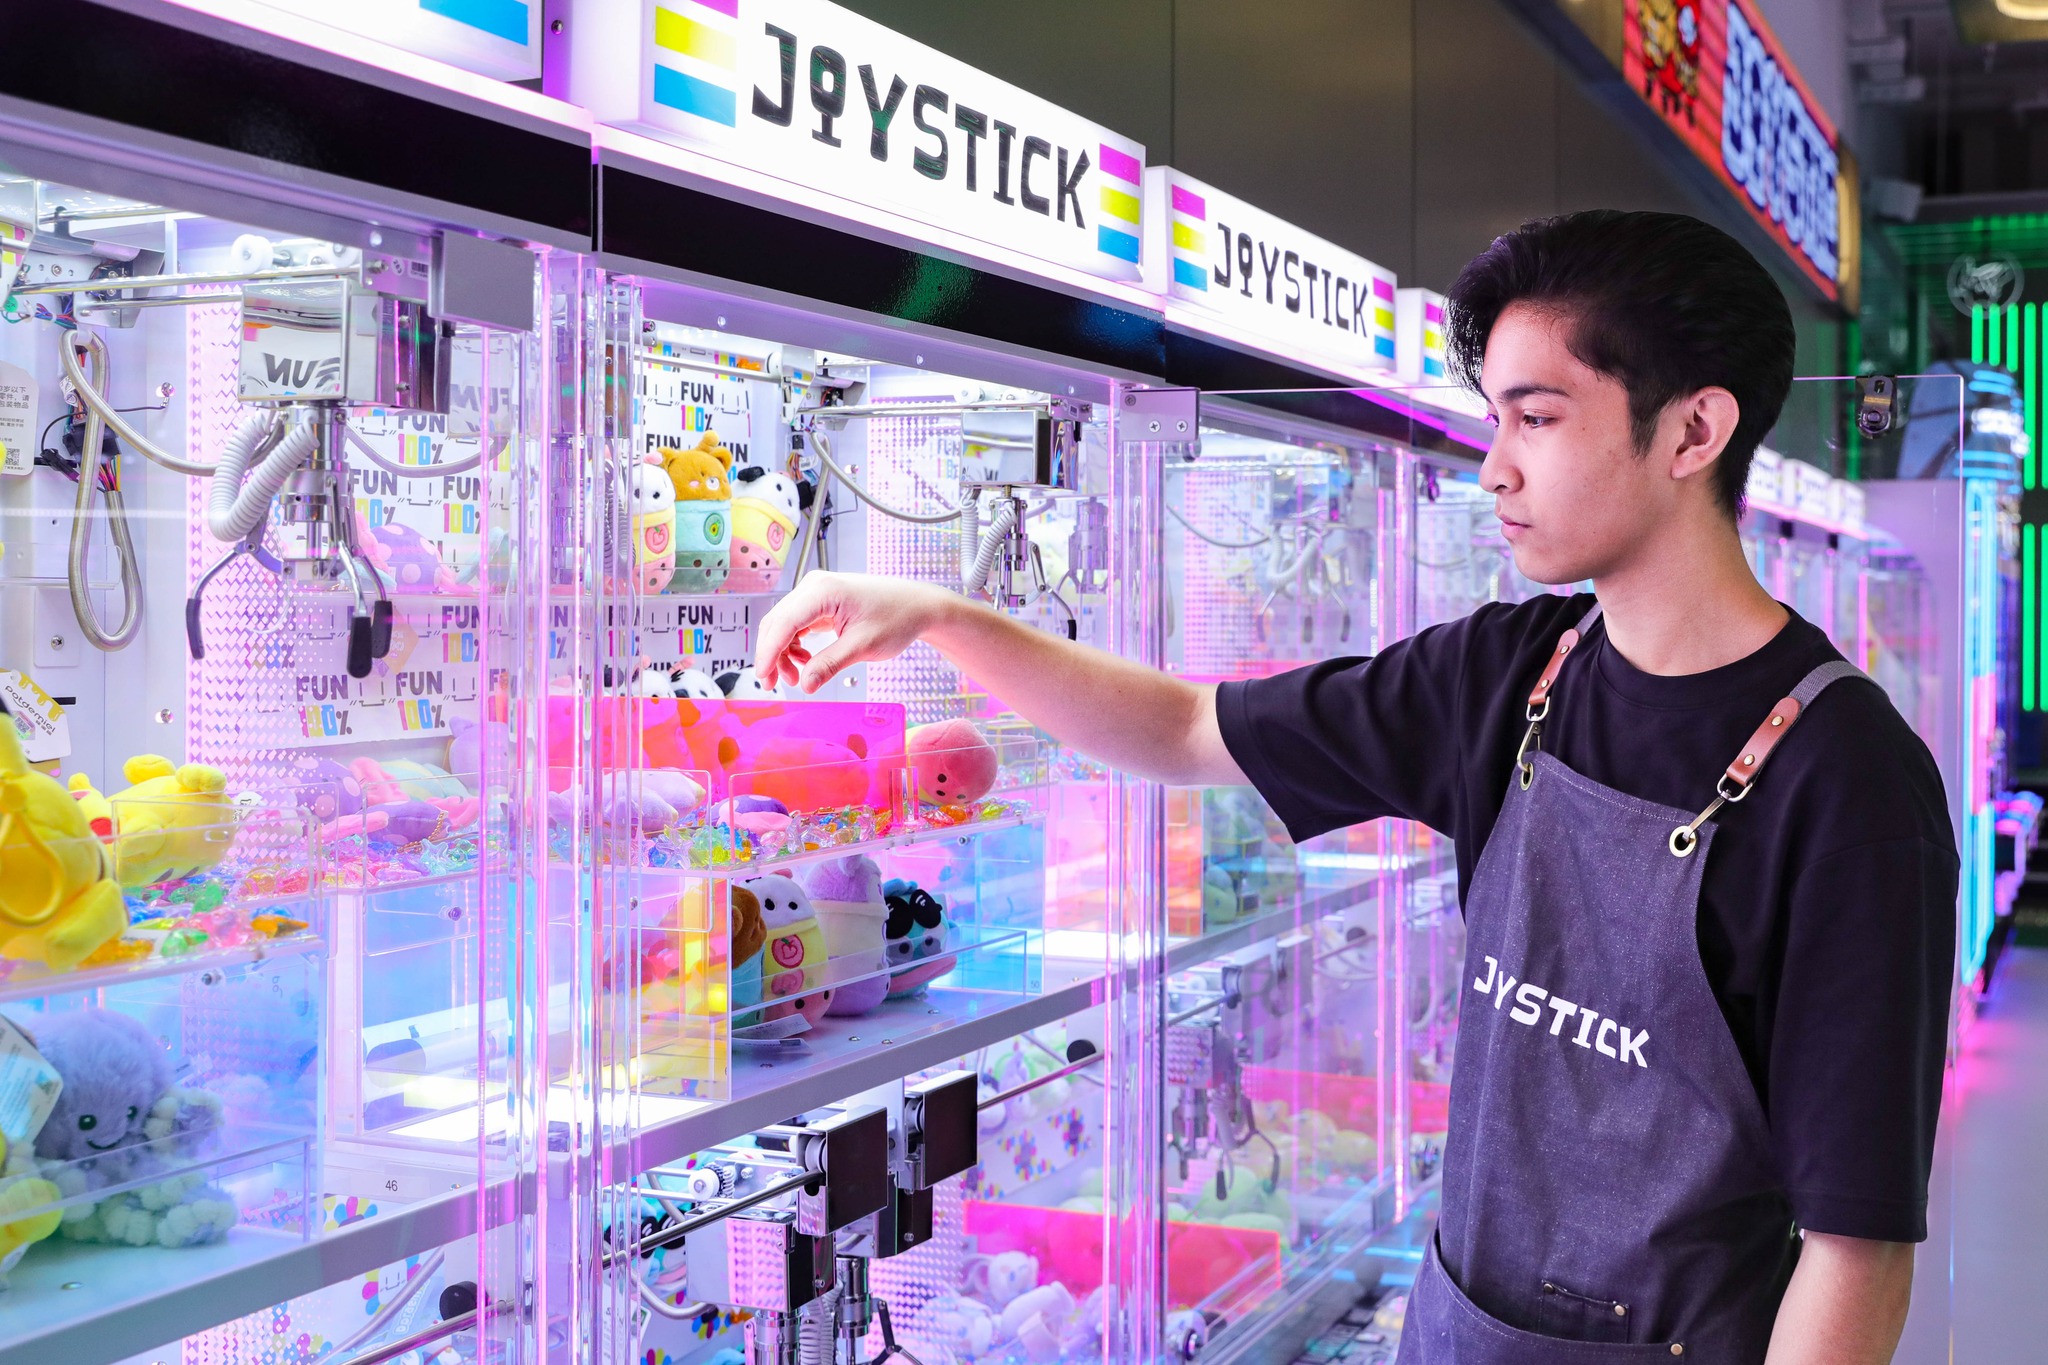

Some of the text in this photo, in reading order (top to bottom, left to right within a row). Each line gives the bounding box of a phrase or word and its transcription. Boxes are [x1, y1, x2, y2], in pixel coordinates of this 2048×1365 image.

[752, 22, 1091, 229] JOYSTICK
[1214, 222, 1368, 338] JOYSTICK
[681, 381, 714, 404] FUN
[681, 405, 713, 432] 100%
[398, 434, 443, 465] 100%
[349, 468, 398, 496] FUN
[443, 476, 492, 500] FUN
[442, 605, 490, 629] FUN
[678, 605, 713, 625] FUN
[678, 628, 712, 655] 100%
[296, 674, 349, 702] FUN
[396, 671, 443, 696] FUN
[297, 704, 353, 738] 100%
[397, 698, 446, 731] 100%
[1473, 955, 1650, 1068] JYSTICK
[385, 1179, 399, 1192] 46
